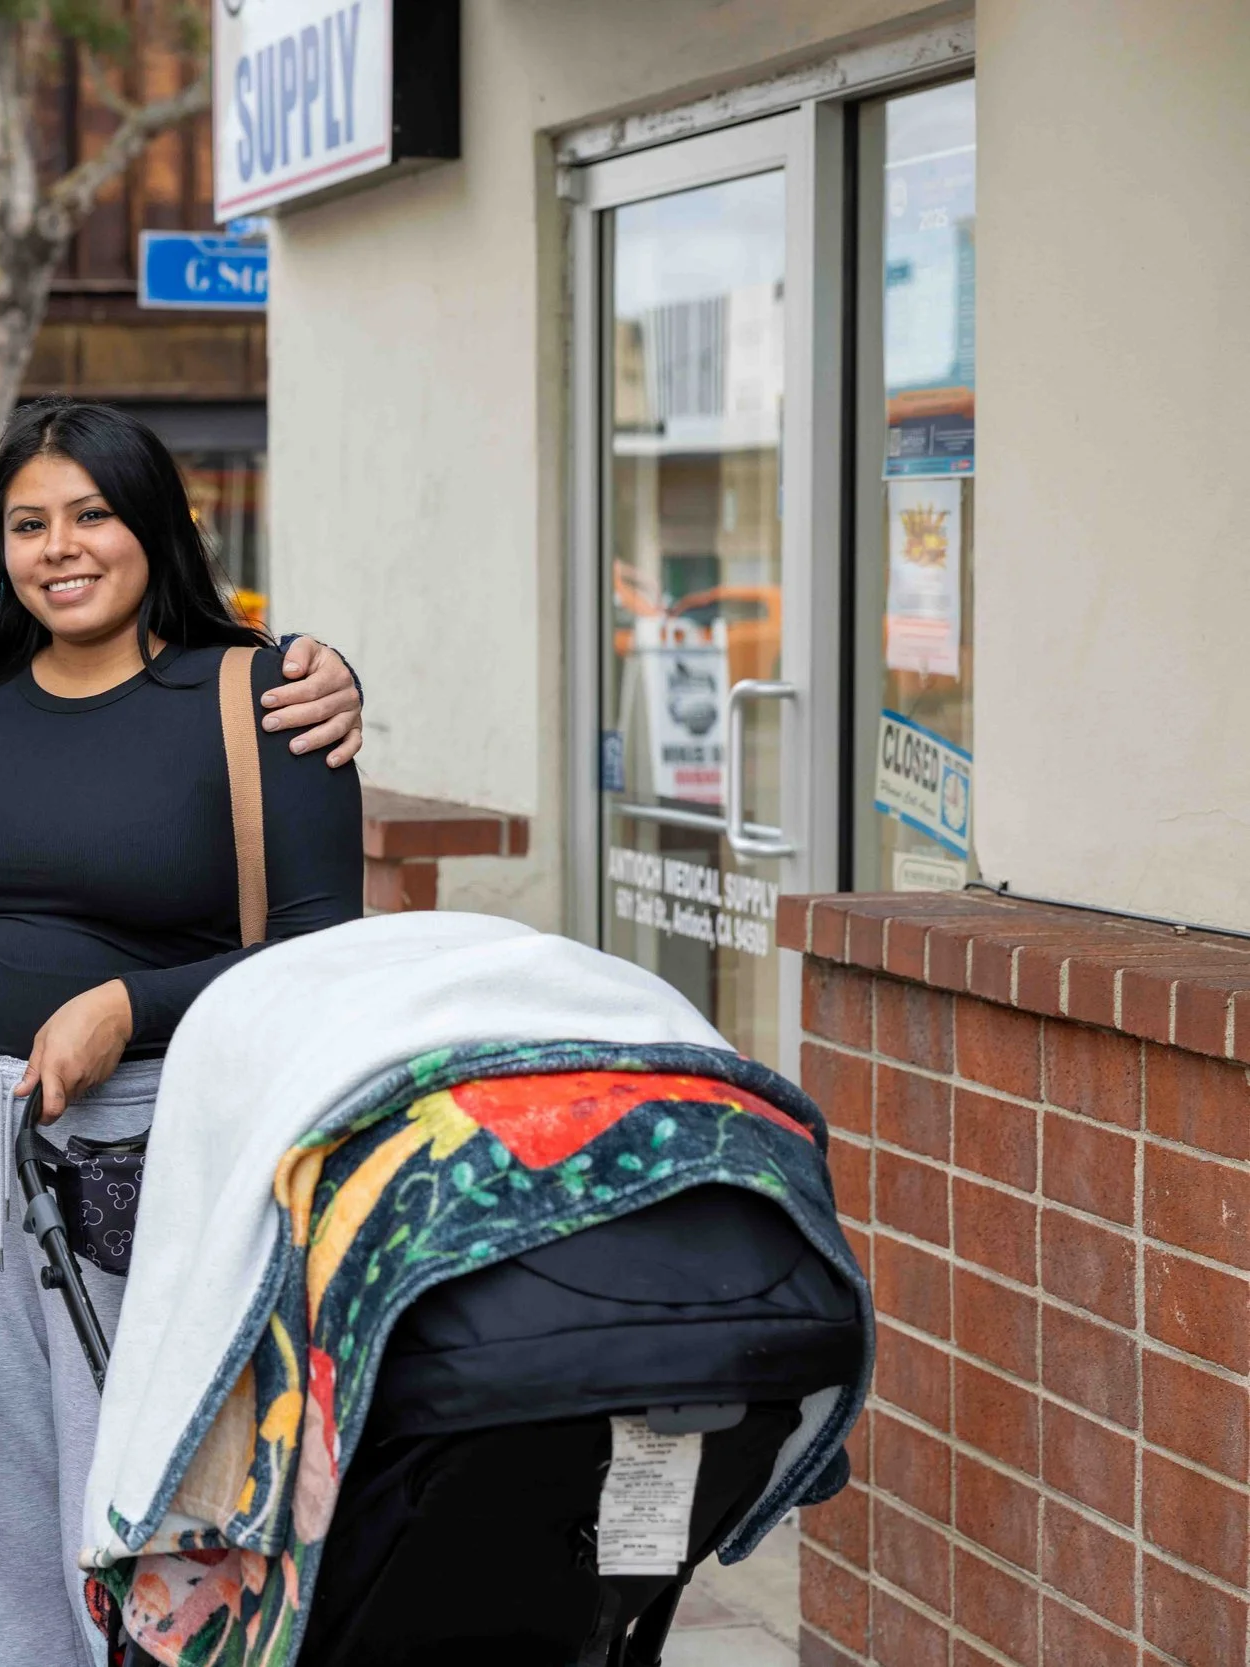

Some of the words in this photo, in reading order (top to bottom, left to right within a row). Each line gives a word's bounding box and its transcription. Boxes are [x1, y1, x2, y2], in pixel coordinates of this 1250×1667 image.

[236, 3, 360, 183] SUPPLY
[882, 724, 940, 793] CLOSED
[608, 846, 663, 891] ANTIOCH
[664, 858, 722, 908] MEDICAL
[723, 871, 779, 921] SUPPLY
